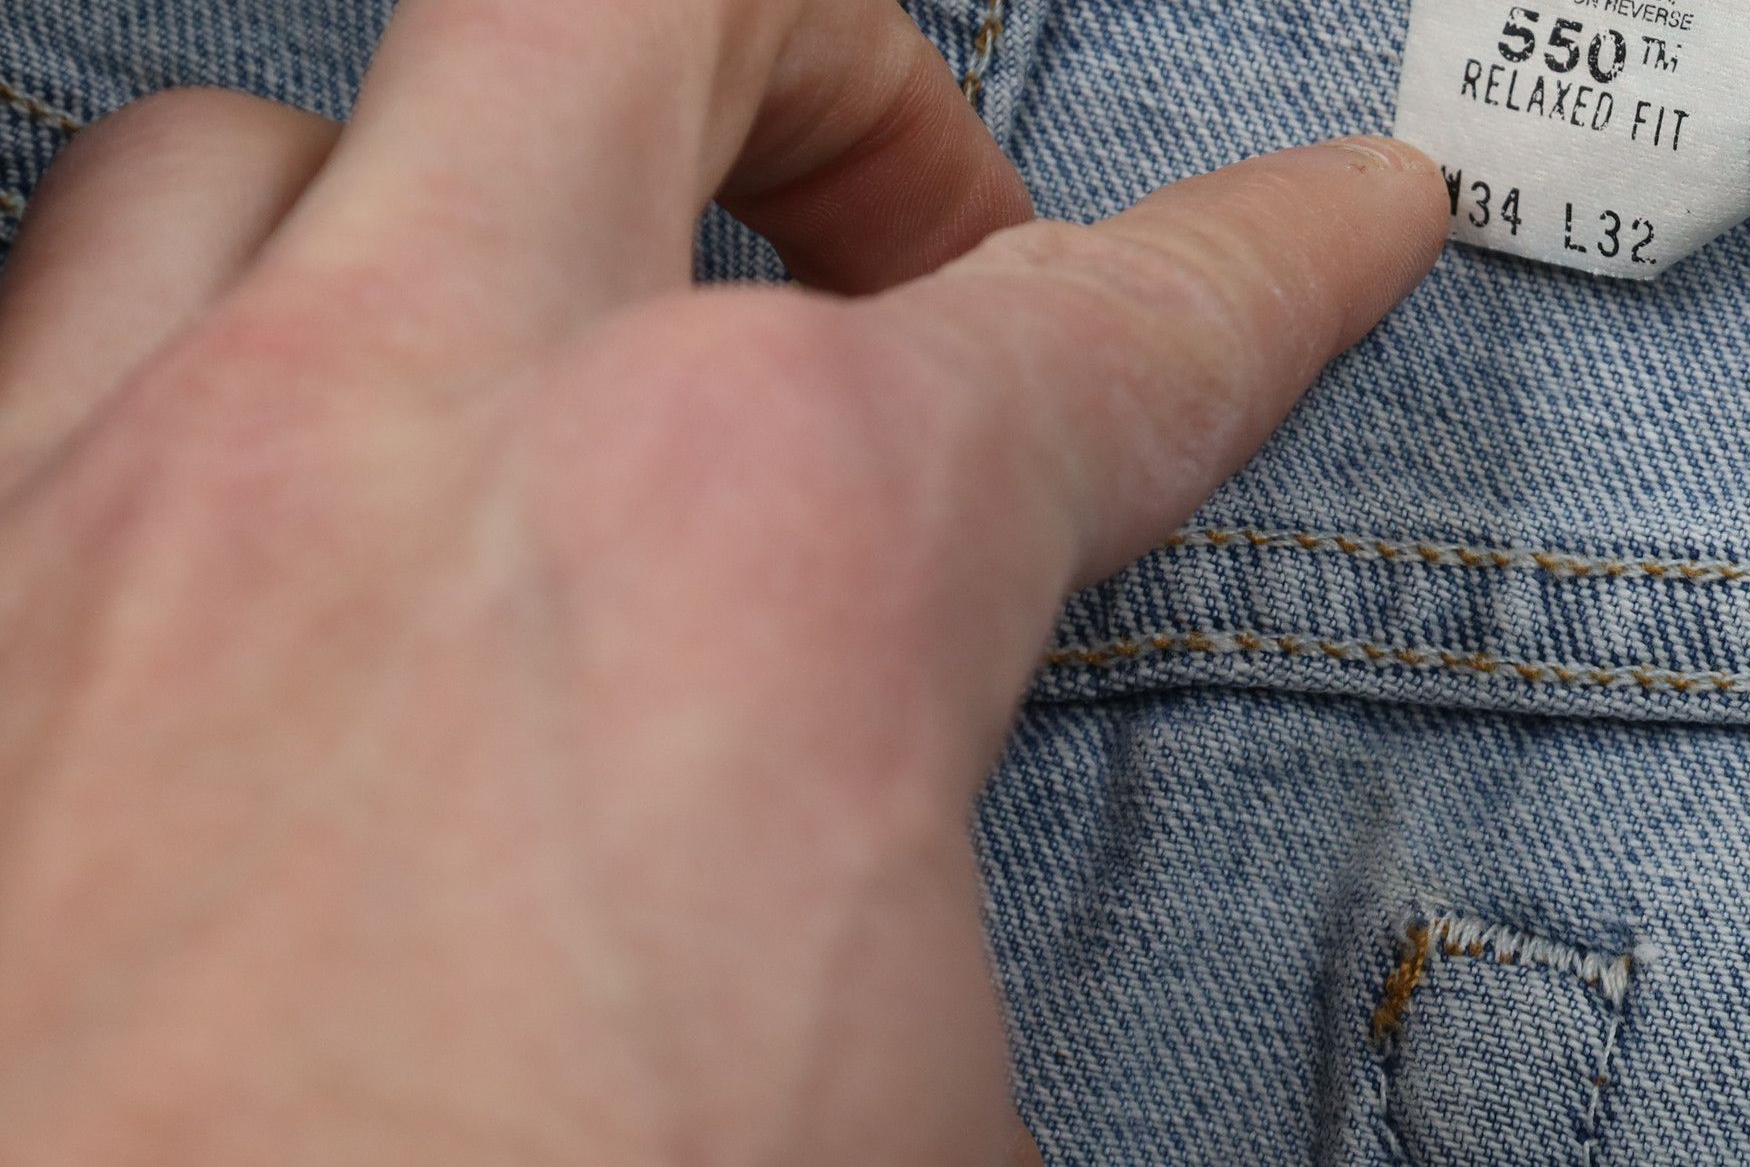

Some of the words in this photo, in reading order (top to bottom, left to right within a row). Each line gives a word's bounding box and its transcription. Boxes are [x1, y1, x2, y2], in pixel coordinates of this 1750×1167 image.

[1460, 58, 1614, 131] RELAXED
[1631, 100, 1690, 151] FIT
[1564, 202, 1658, 265] L32
